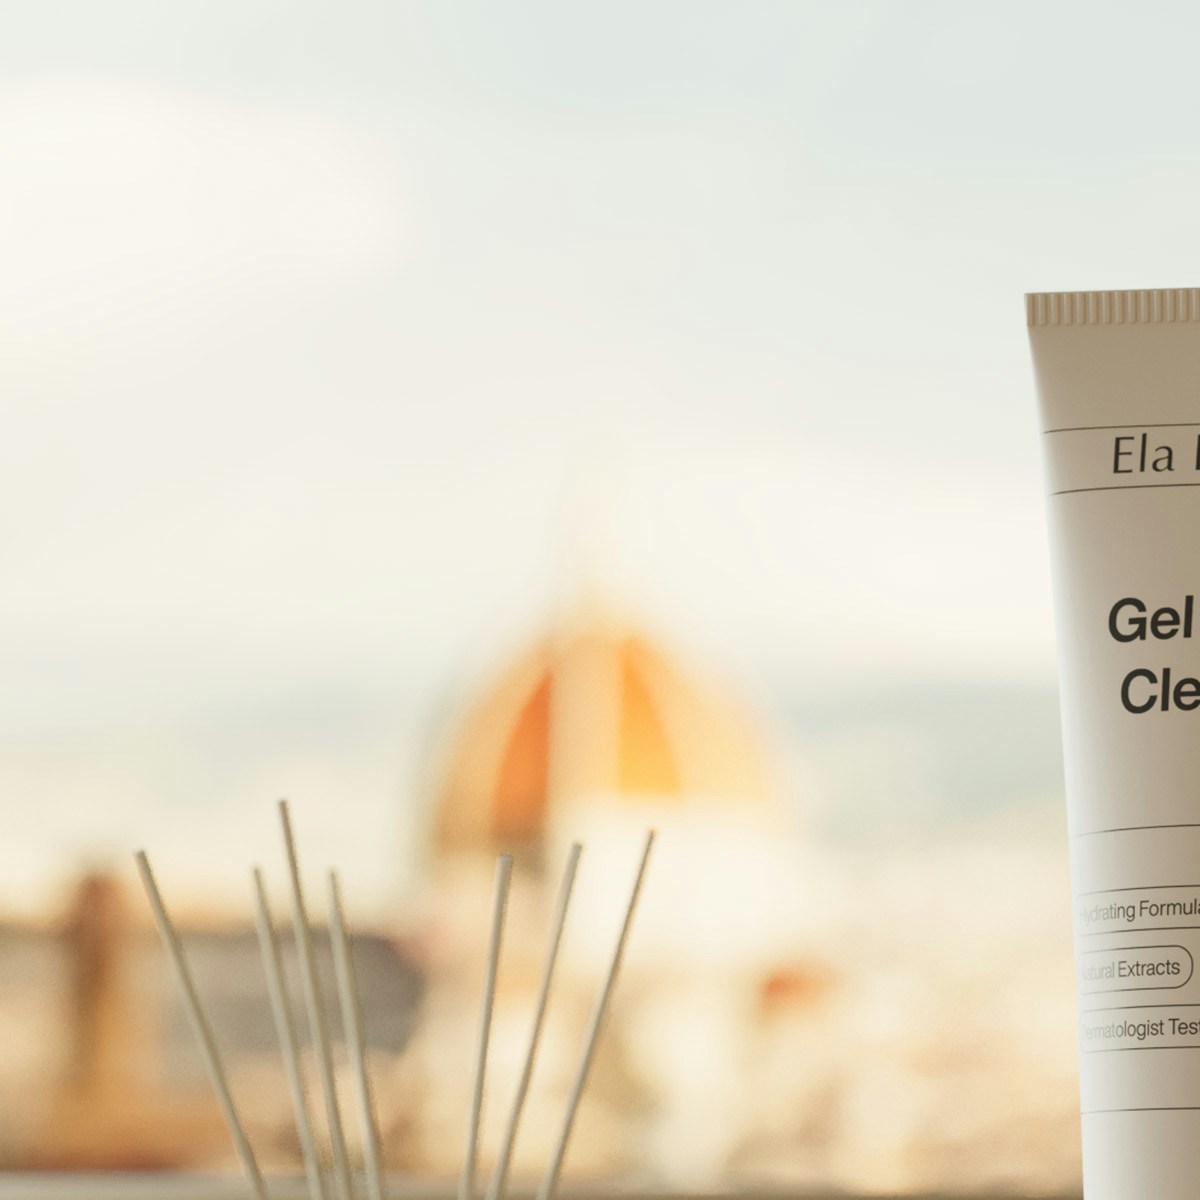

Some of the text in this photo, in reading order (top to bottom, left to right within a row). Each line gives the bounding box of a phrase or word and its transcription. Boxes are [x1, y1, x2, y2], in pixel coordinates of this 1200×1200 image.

[1112, 433, 1175, 474] Ela
[1107, 595, 1194, 643] Gel
[1118, 959, 1181, 978] Extracts
